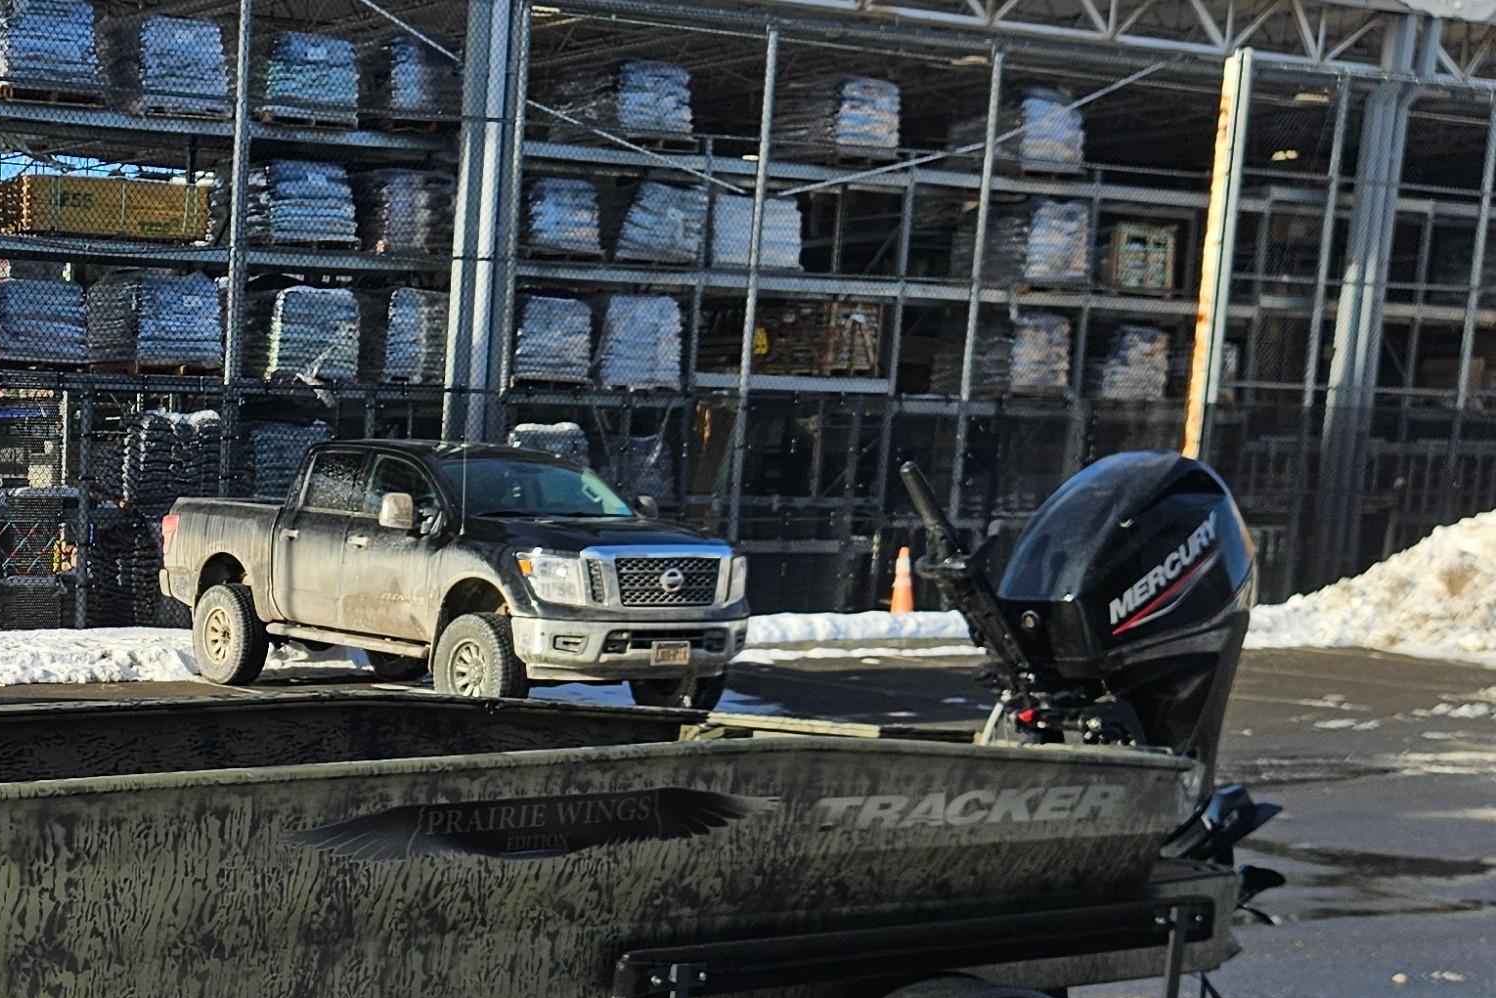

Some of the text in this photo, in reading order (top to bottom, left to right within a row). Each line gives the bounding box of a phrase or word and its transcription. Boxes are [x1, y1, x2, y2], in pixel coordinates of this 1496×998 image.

[1109, 510, 1217, 625] MERCURY
[425, 796, 652, 836] PRAIRIE WINGS
[815, 785, 1125, 828] TRACKER
[506, 833, 569, 851] EDITION
